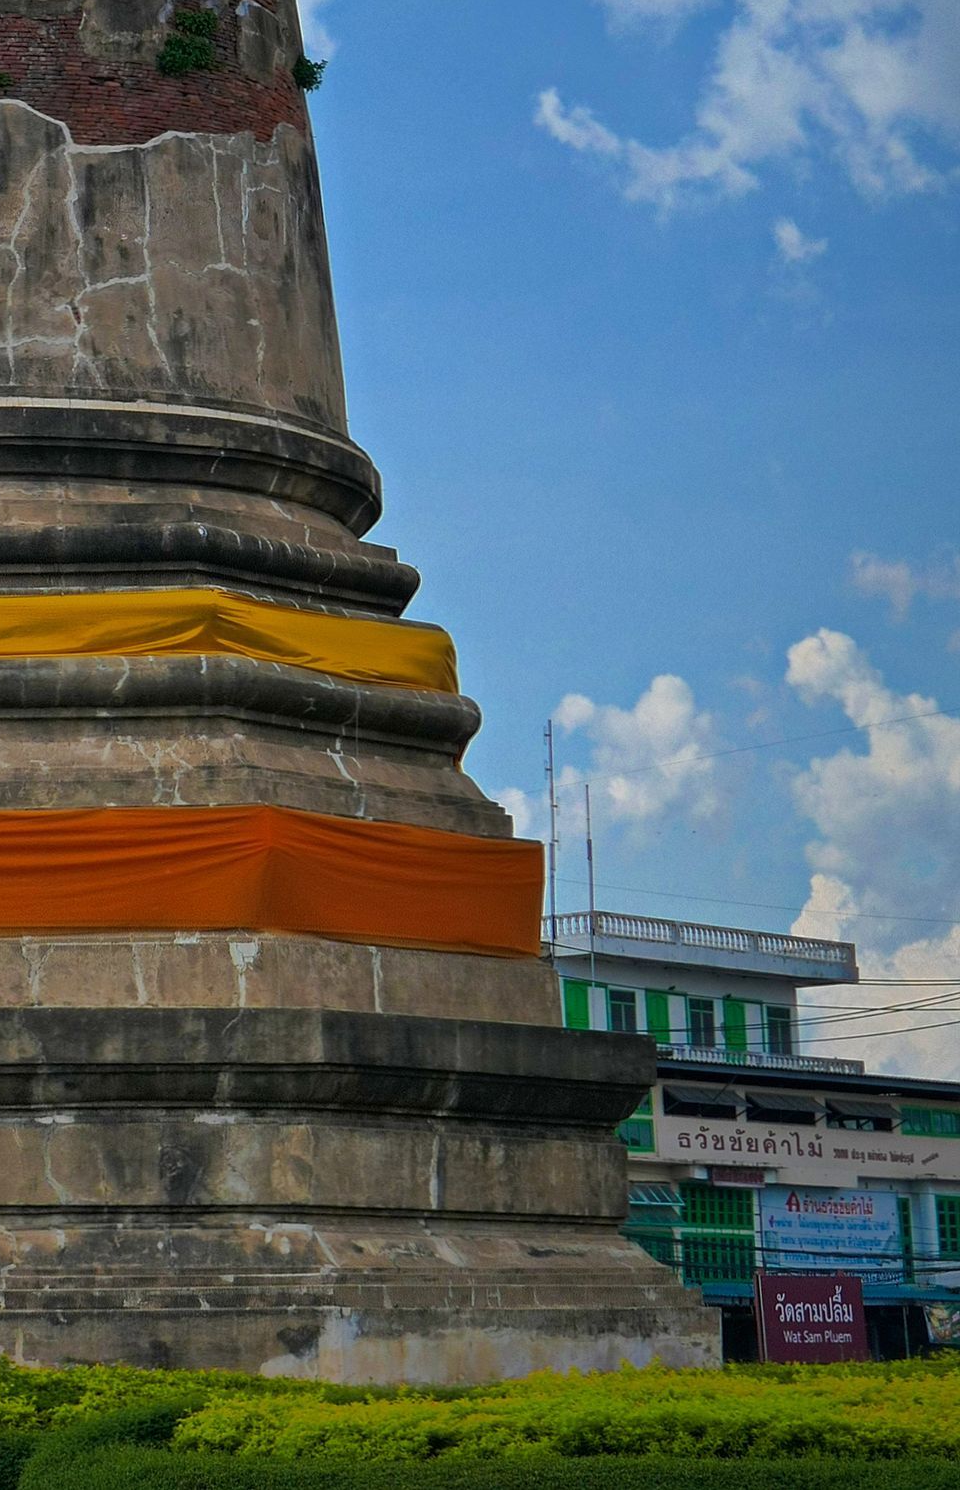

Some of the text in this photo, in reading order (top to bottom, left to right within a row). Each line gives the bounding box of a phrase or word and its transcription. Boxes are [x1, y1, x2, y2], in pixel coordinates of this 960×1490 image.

[677, 1126, 823, 1158] ธวัชชัยค้าไม้
[775, 1285, 854, 1323] วัดสามปลื้ม
[783, 1329, 853, 1343] Wat Sam Pluem
